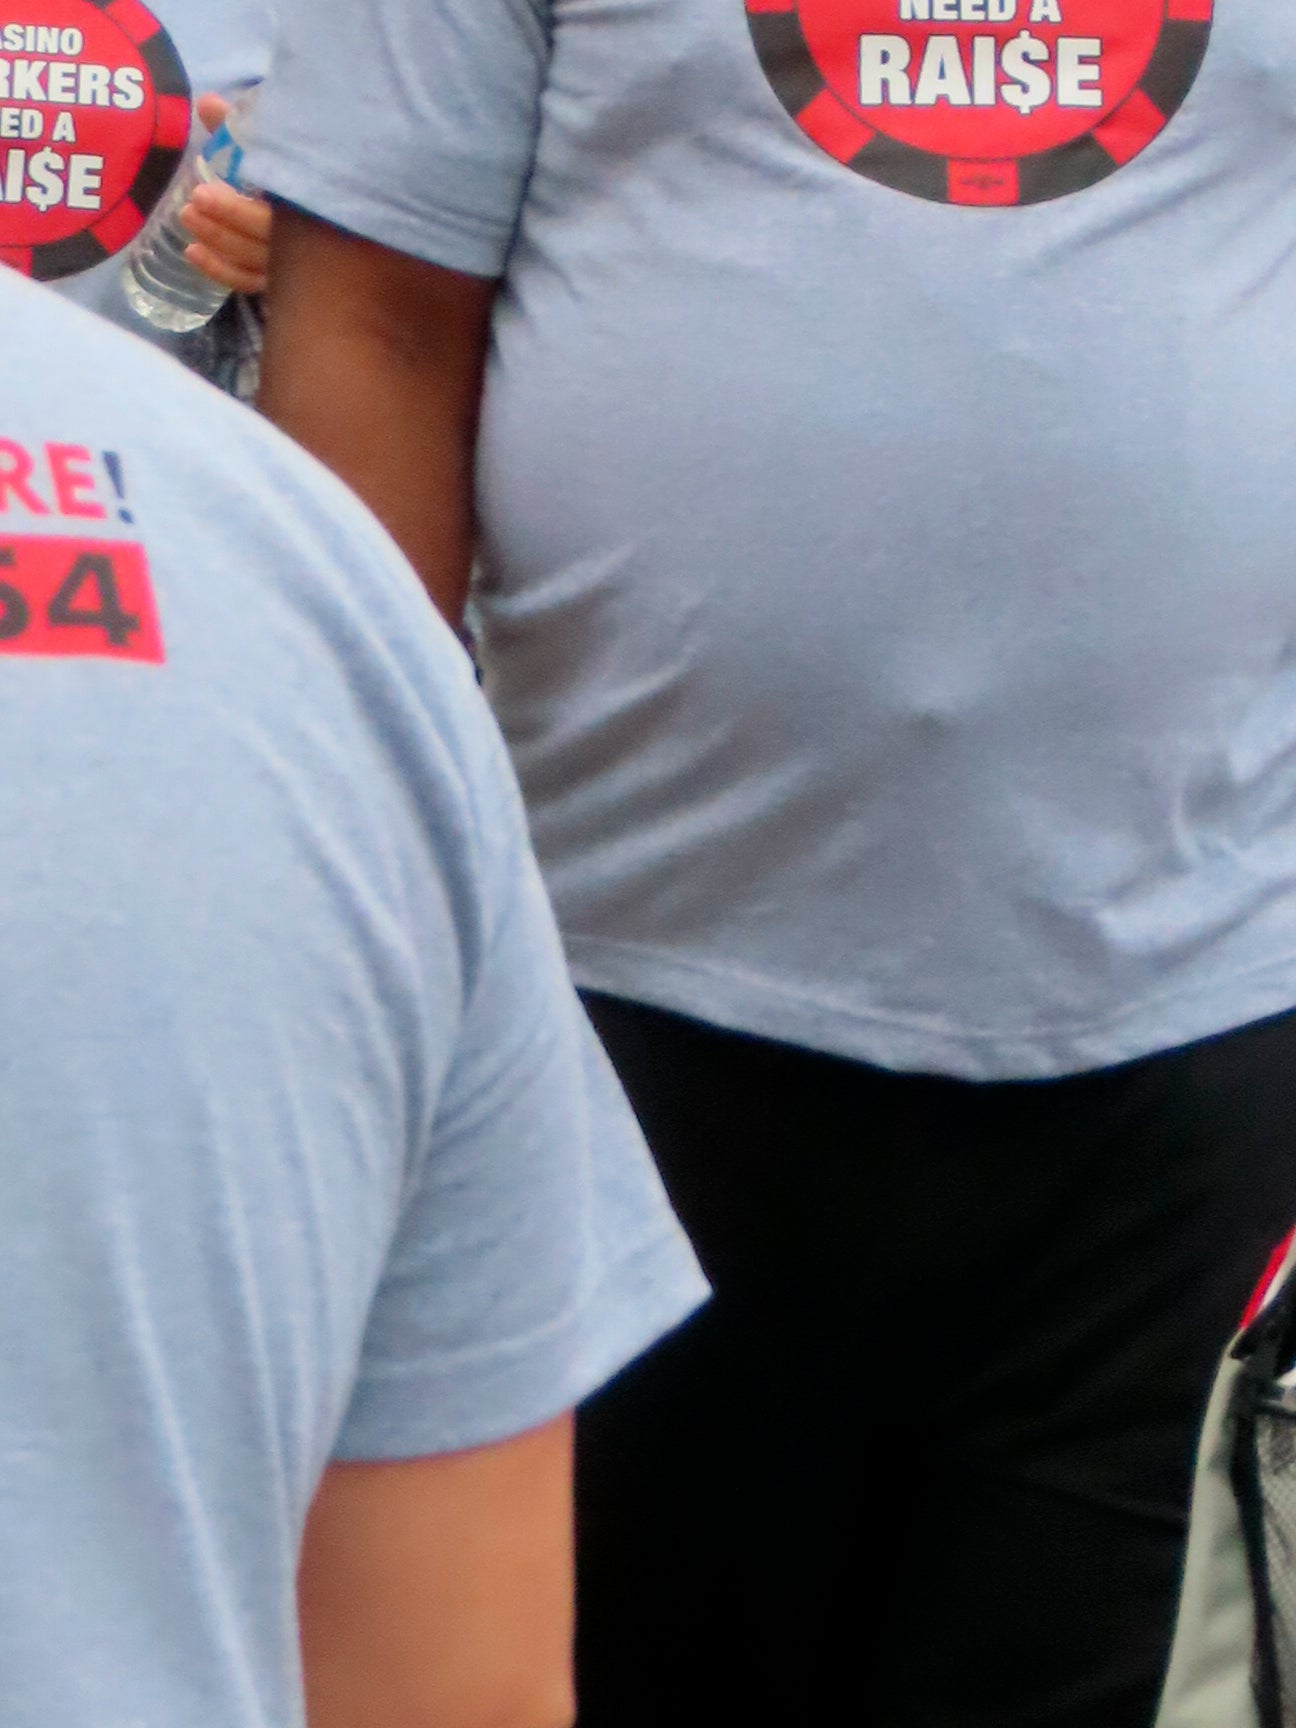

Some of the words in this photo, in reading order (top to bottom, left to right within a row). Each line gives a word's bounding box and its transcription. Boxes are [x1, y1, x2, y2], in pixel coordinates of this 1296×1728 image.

[0, 23, 83, 57] SINO
[857, 30, 1104, 115] RAI$E
[52, 111, 76, 143] A
[0, 146, 104, 212] I$E
